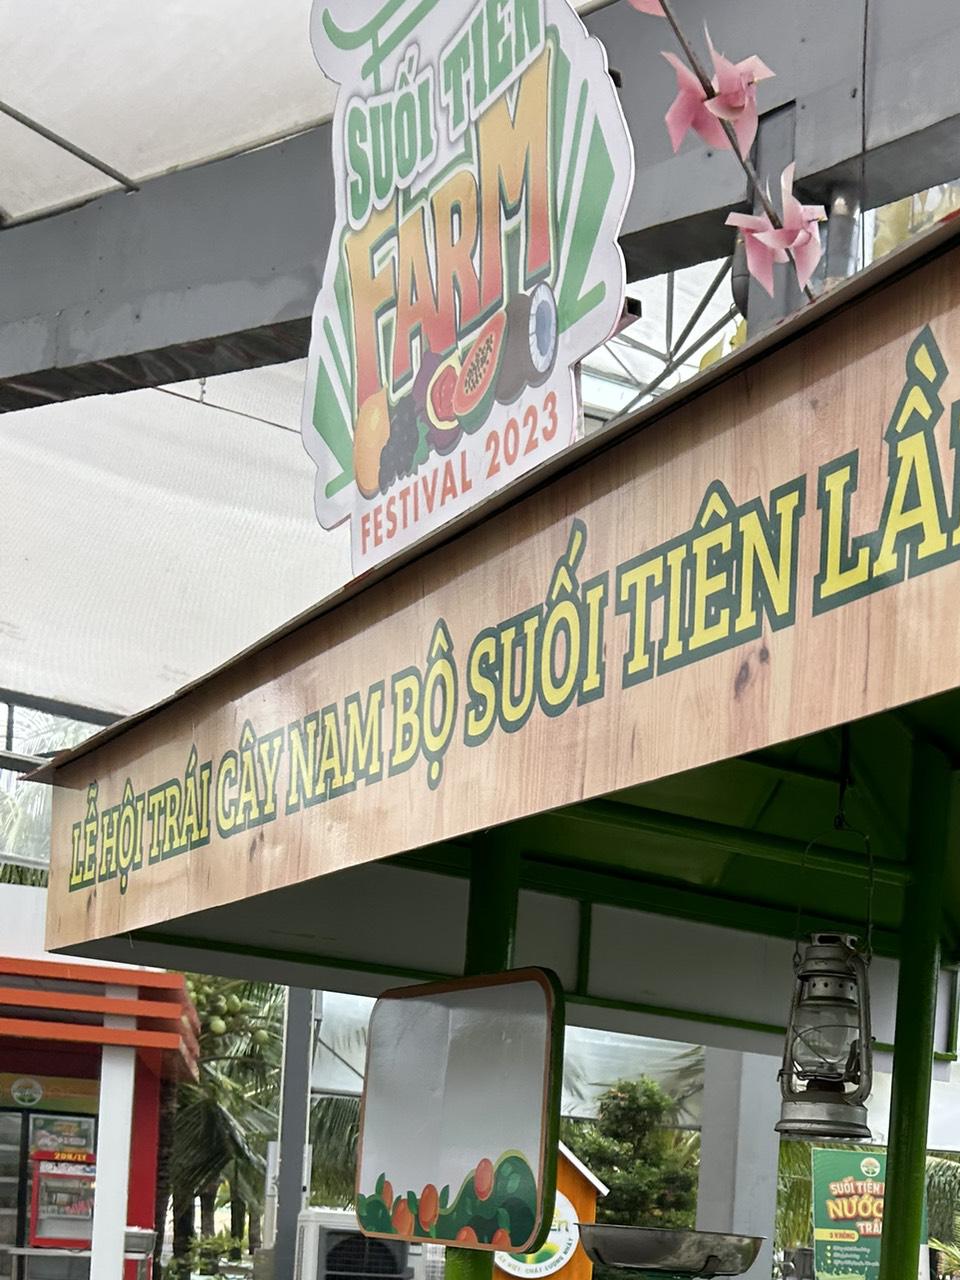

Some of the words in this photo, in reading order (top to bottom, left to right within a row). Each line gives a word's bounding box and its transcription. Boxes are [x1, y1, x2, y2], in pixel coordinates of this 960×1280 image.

[345, 45, 553, 405] FARM
[348, 49, 436, 223] SUỐI
[360, 449, 474, 557] FESTIVAL
[485, 391, 560, 475] 2023
[70, 783, 98, 892] LỄ
[99, 778, 145, 895] HỘI
[147, 743, 212, 866] TRÁI
[217, 719, 285, 839] CÂY
[285, 680, 385, 816] NAM
[388, 617, 458, 791] BỘ
[464, 518, 609, 747] SUỐI
[615, 480, 806, 689] TIÊN
